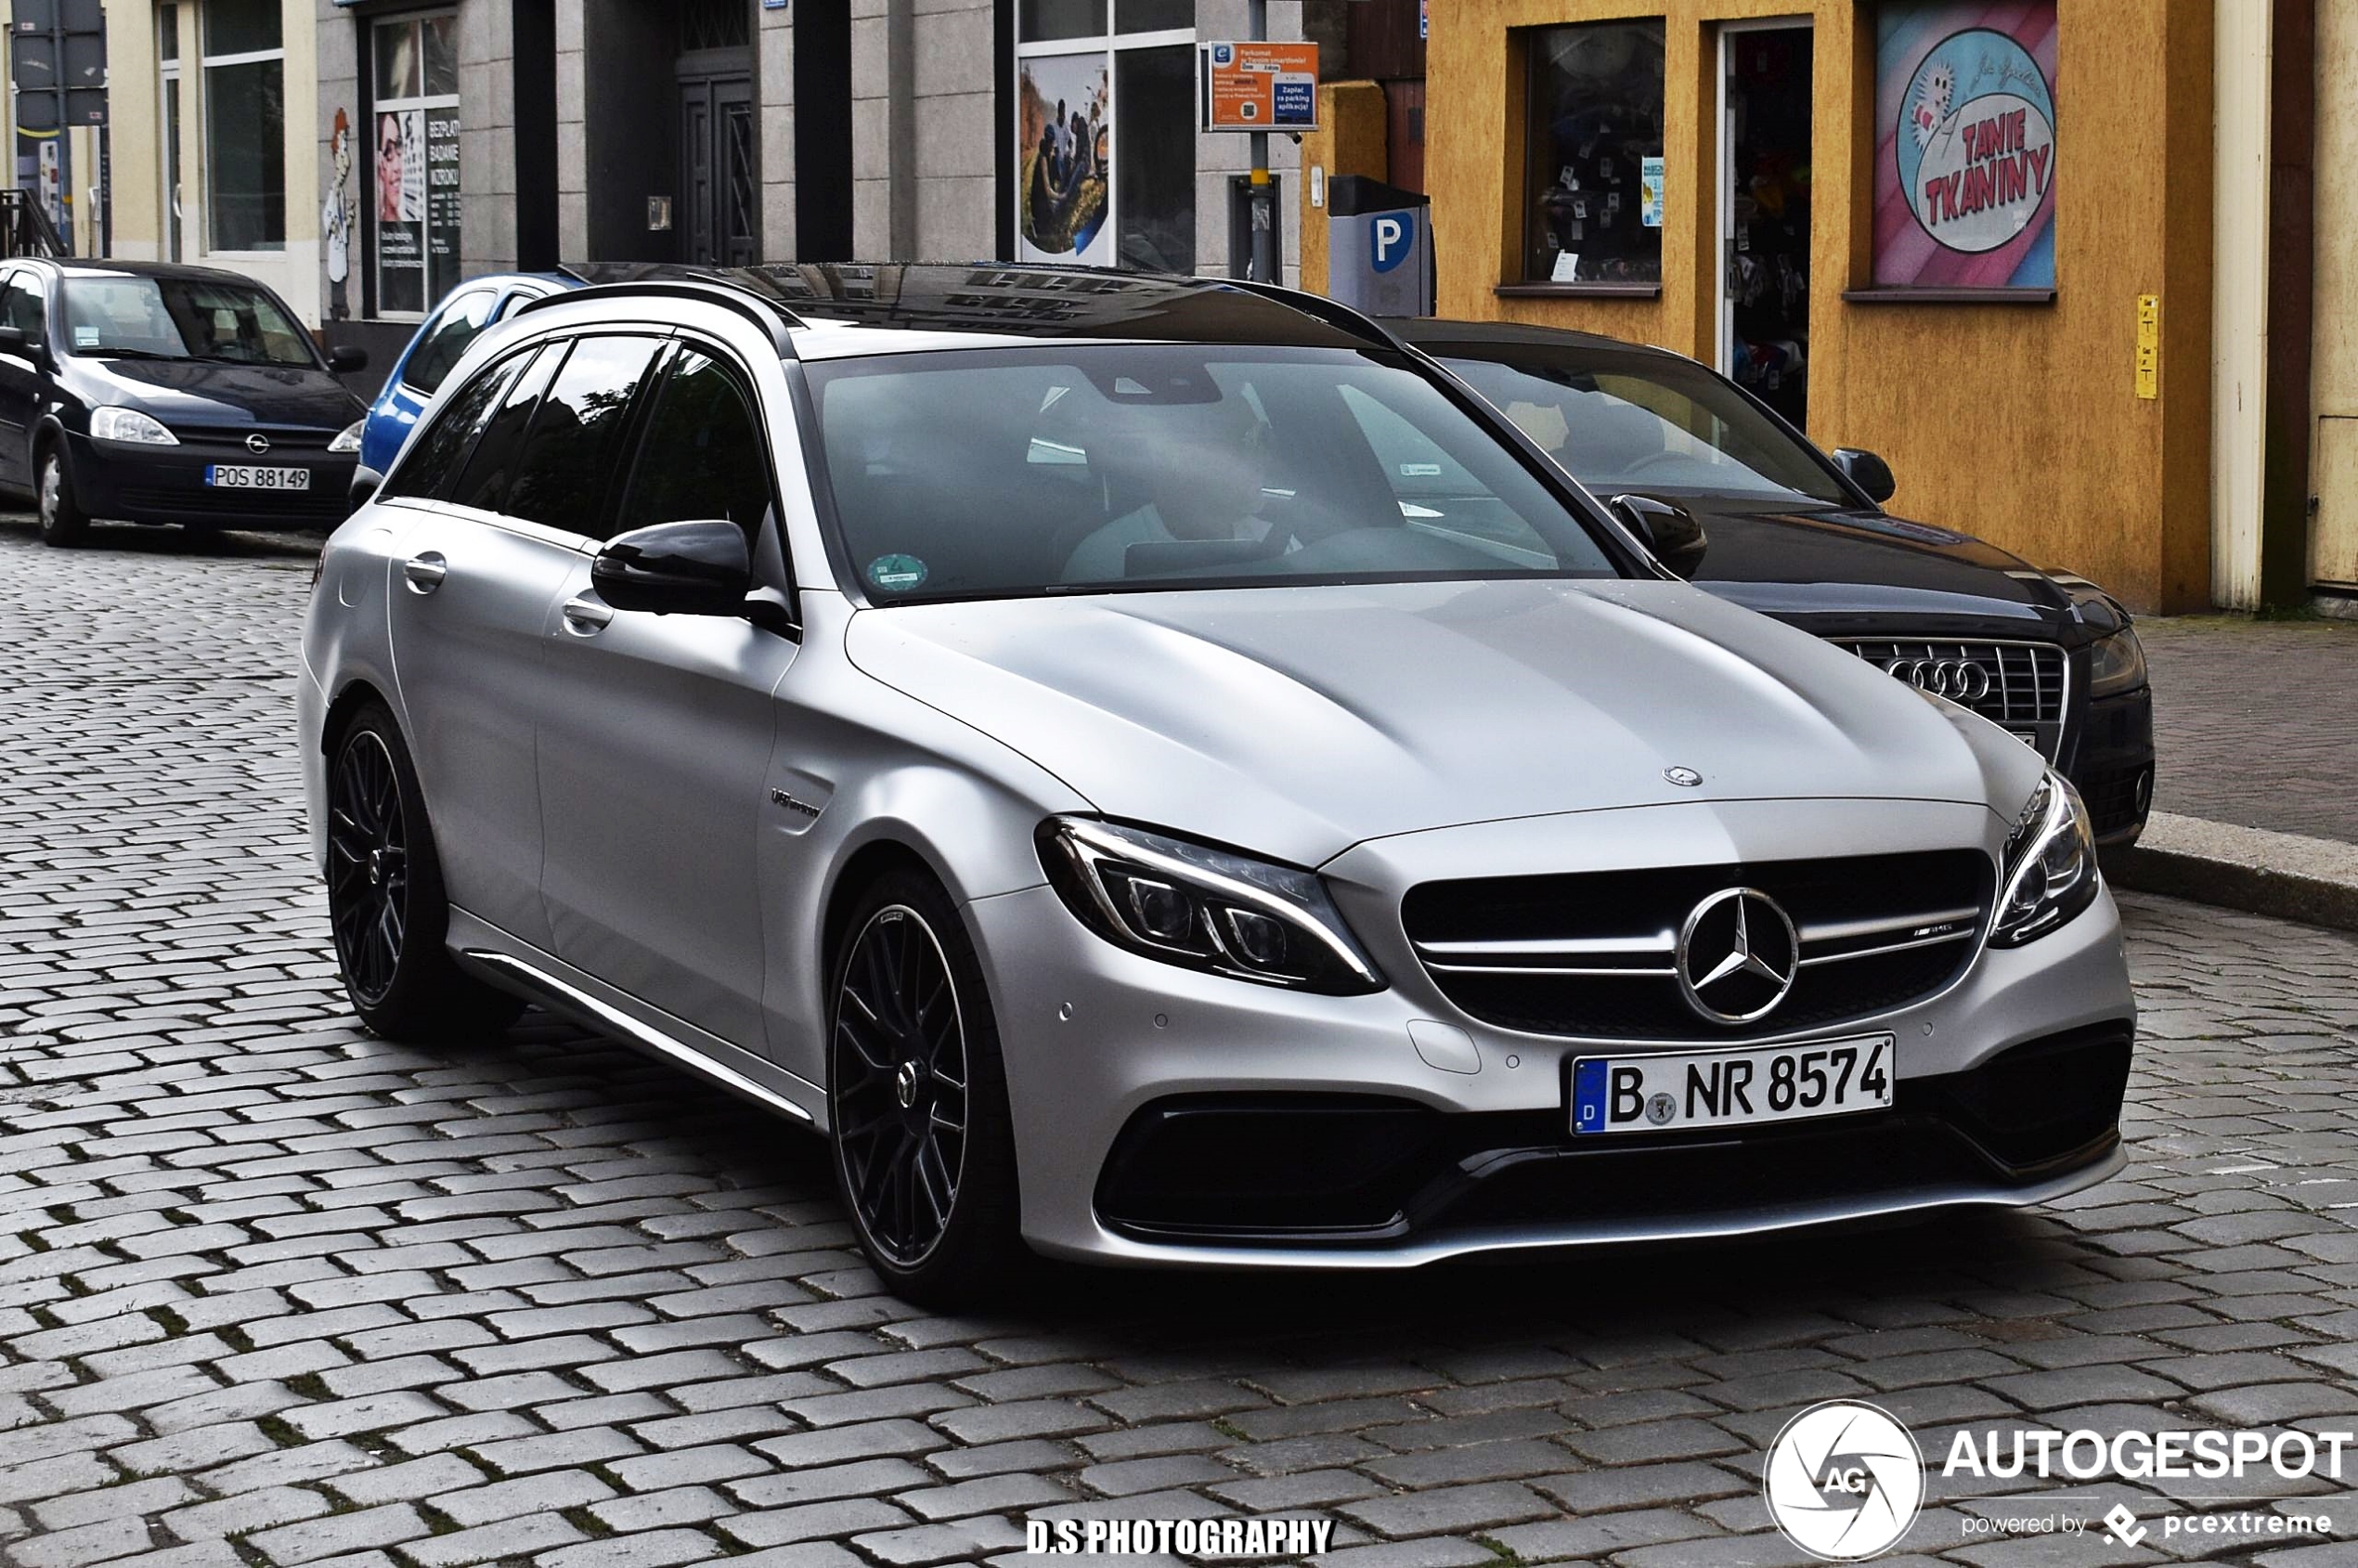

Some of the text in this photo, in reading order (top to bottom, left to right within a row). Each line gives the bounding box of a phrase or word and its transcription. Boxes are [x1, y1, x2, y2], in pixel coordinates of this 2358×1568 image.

[1285, 95, 1310, 103] parking
[1963, 108, 2026, 164] TANIE
[1925, 143, 2050, 226] TKANINY
[1377, 219, 1402, 262] P
[214, 467, 307, 487] POS 88149
[1610, 1043, 1887, 1123] B NR 8574
[1583, 1104, 1595, 1121] D
